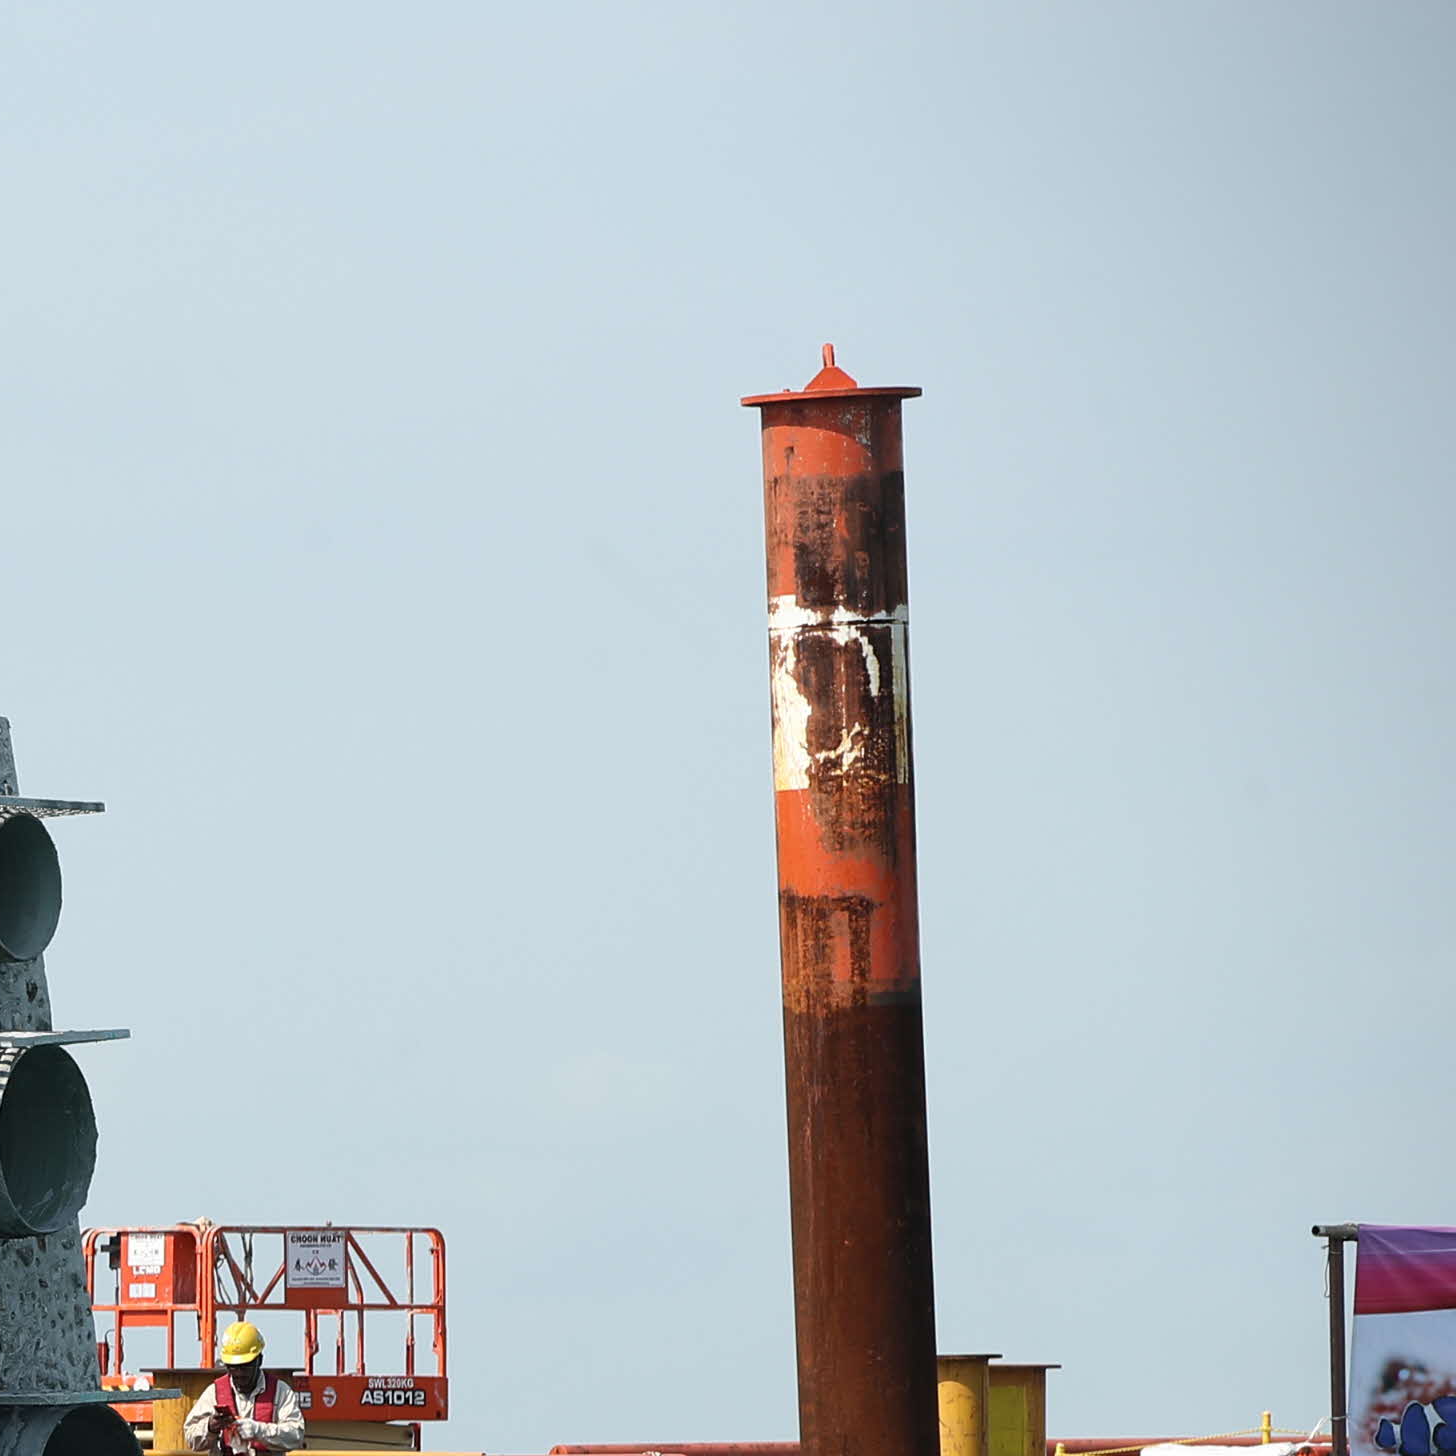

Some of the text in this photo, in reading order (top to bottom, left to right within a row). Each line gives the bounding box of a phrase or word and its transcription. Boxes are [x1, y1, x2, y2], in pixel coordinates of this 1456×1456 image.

[290, 1234, 341, 1244] CHOON HUAT
[368, 1378, 414, 1389] SWL320KG
[361, 1390, 425, 1406] AS1012
